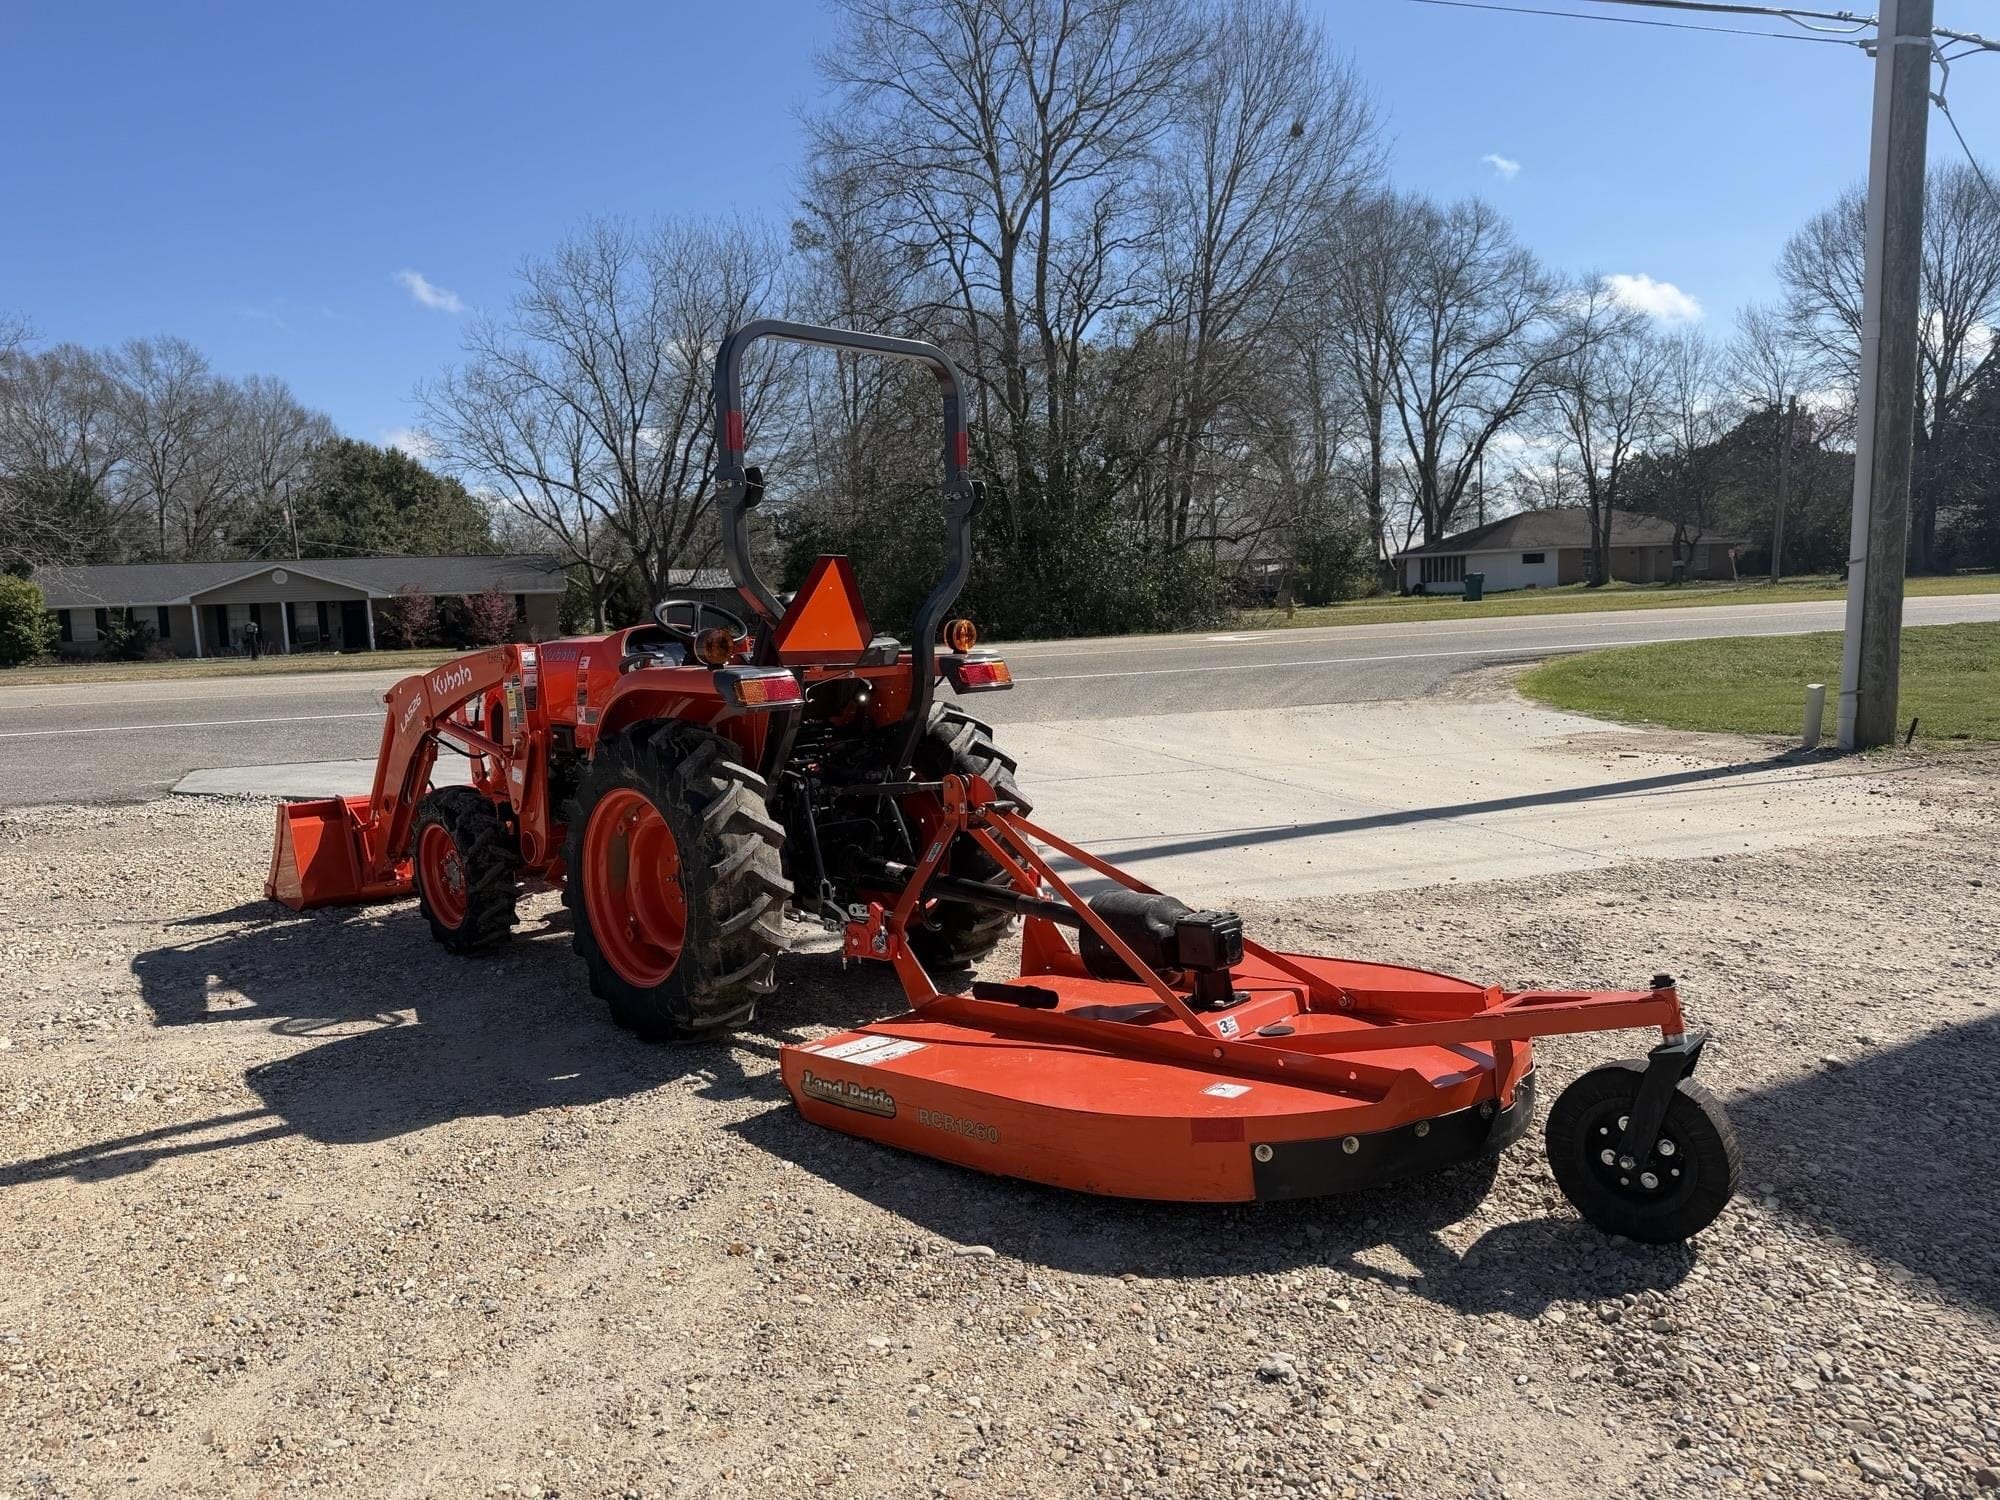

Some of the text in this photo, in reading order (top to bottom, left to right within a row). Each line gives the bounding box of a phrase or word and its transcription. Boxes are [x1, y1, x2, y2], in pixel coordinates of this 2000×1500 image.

[432, 664, 473, 695] Kubota
[803, 1070, 895, 1109] Land Pride
[917, 1107, 1000, 1144] RCR1260
